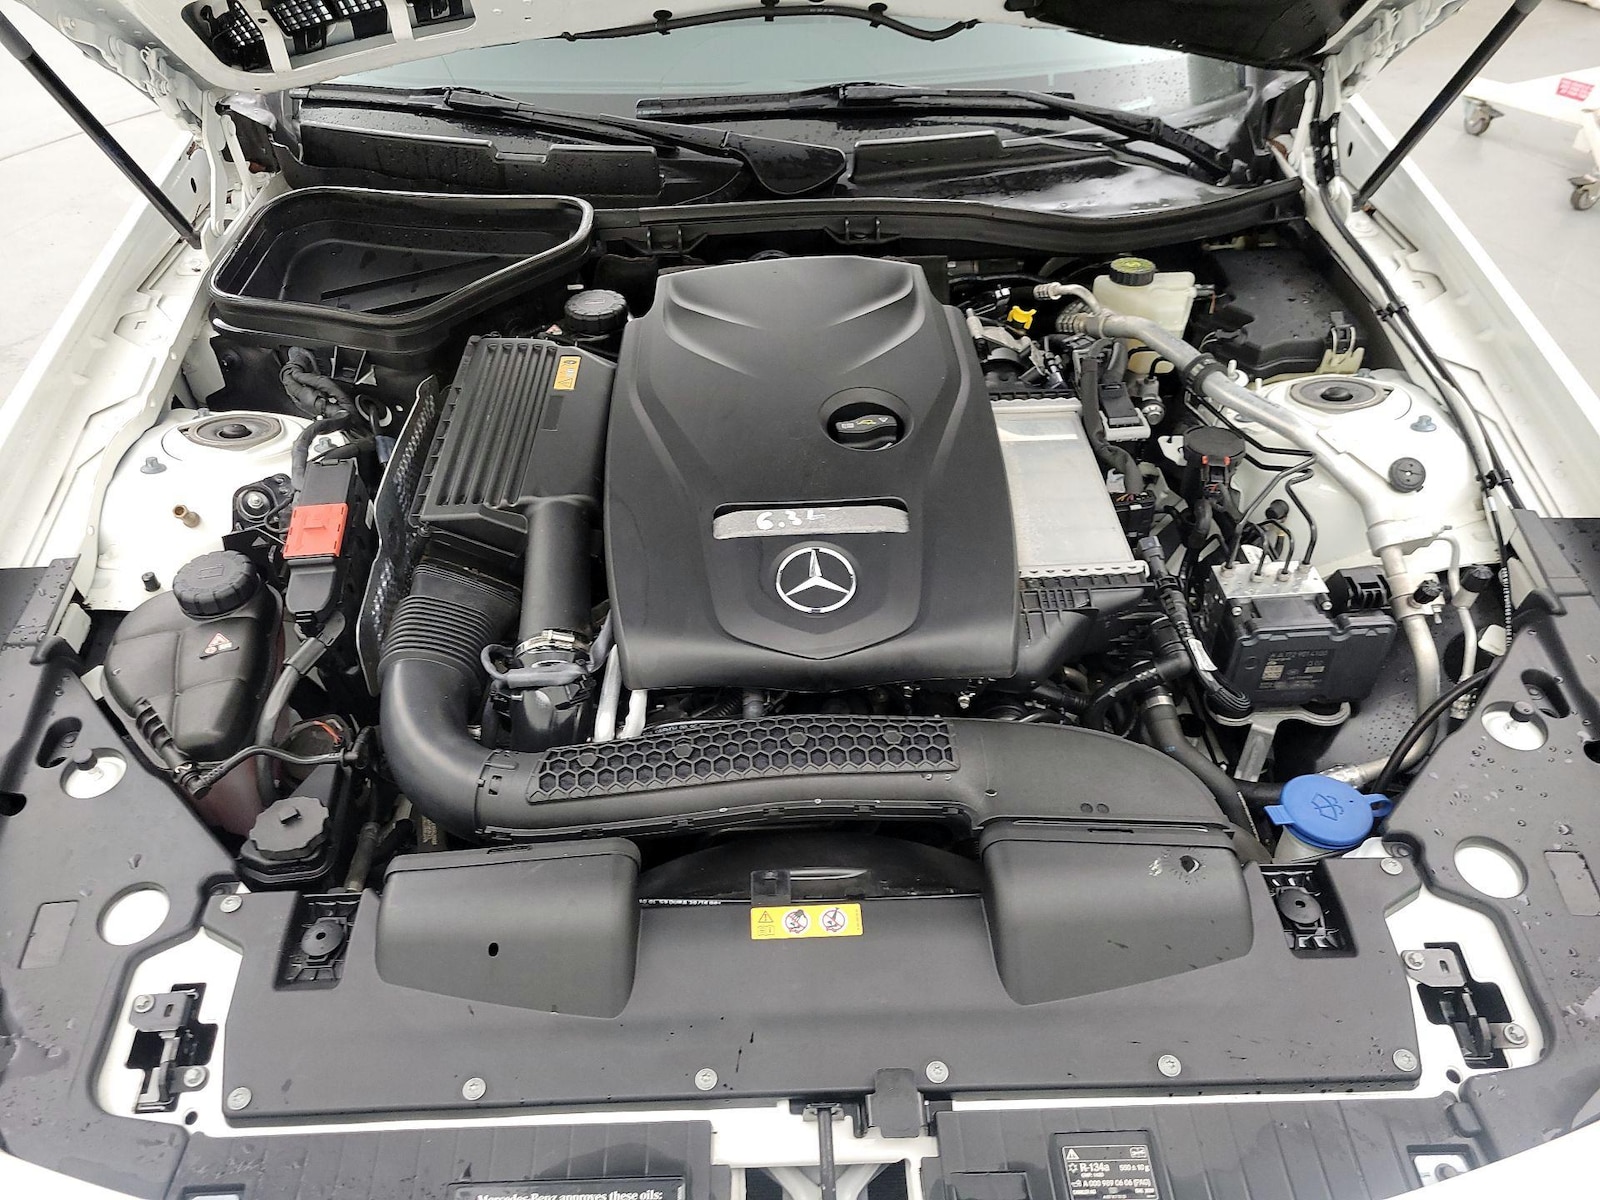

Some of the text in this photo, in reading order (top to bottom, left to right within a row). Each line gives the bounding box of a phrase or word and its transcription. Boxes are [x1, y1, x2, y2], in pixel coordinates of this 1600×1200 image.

[1080, 1162, 1110, 1172] R-134a
[609, 1191, 638, 1200] these
[639, 1189, 663, 1200] oils:
